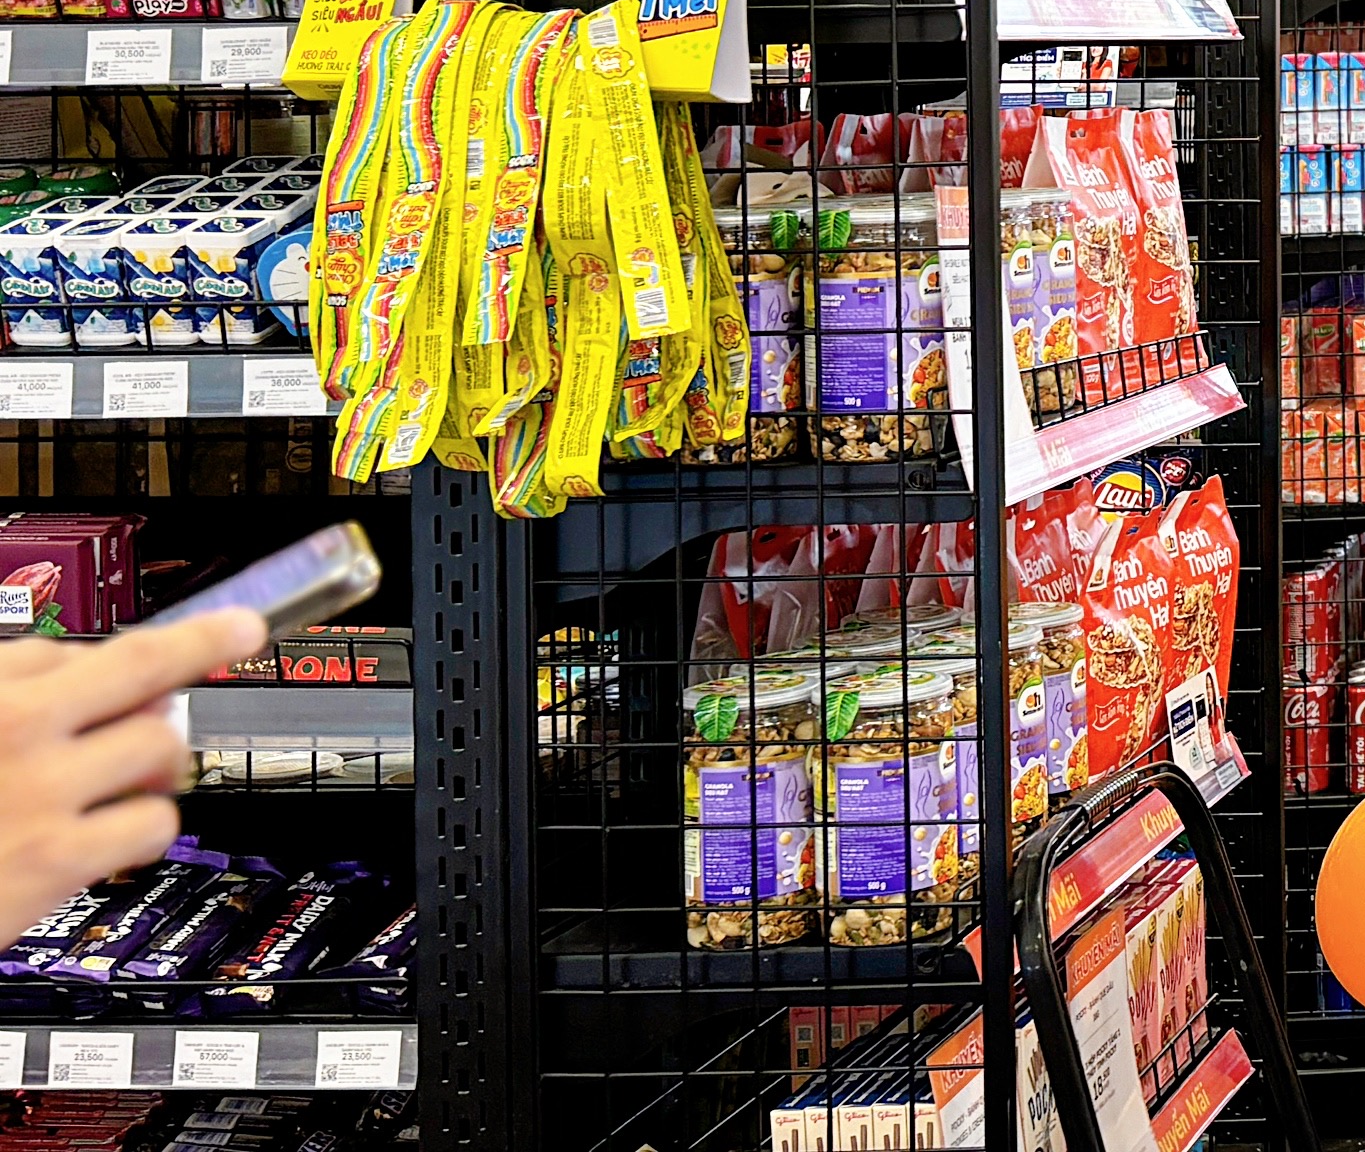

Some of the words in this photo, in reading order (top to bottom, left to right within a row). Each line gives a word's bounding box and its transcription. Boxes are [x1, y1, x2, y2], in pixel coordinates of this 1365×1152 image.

[312, 6, 335, 21] SIÊU
[1179, 527, 1212, 554] Bánh
[1024, 553, 1057, 582] Bánh
[1114, 555, 1142, 585] Bánh
[1184, 543, 1232, 578] Thuyền
[1114, 573, 1168, 611] Thuyền
[1187, 1082, 1211, 1125] Mãi
